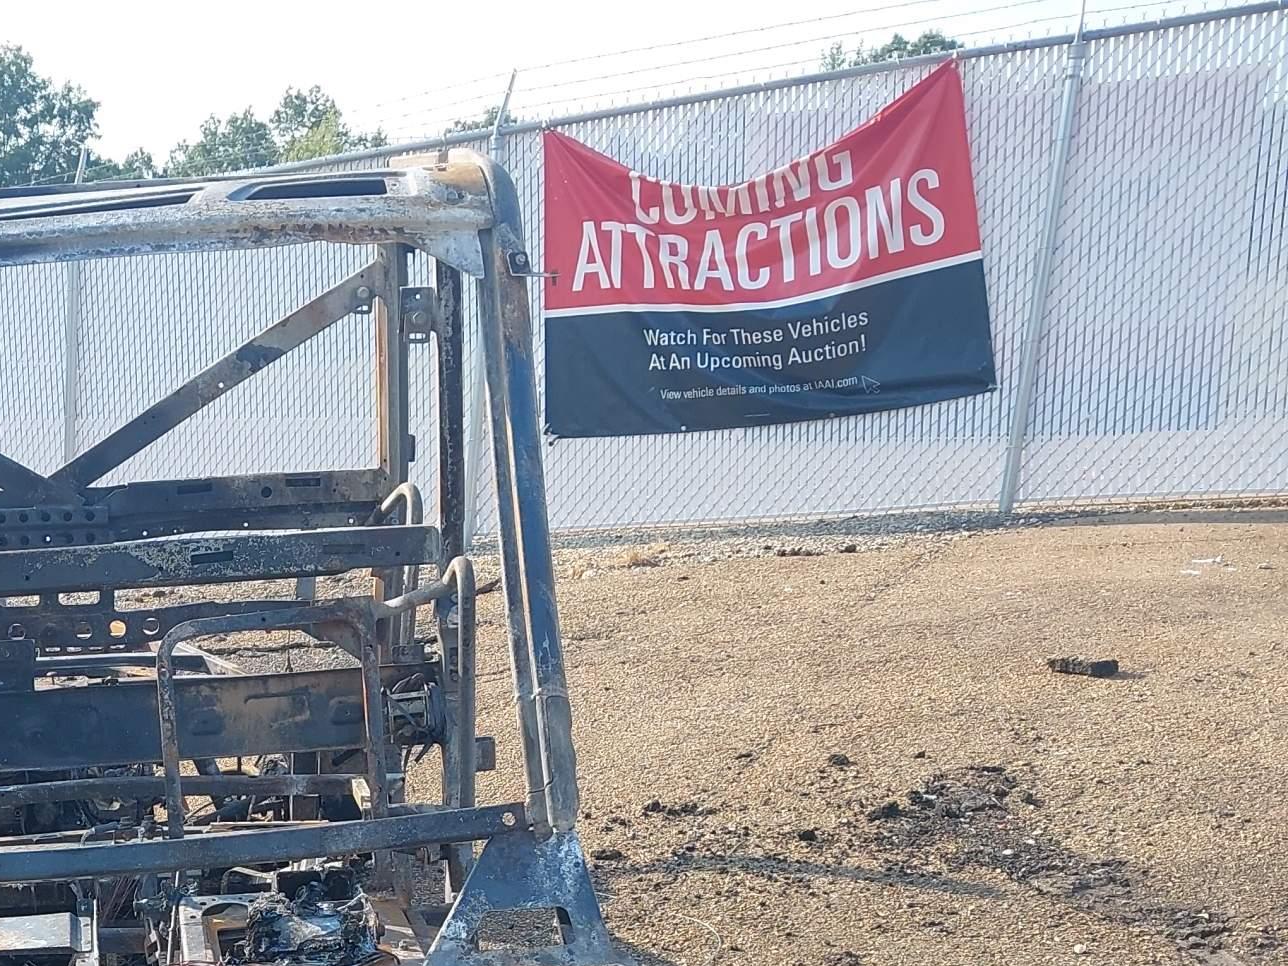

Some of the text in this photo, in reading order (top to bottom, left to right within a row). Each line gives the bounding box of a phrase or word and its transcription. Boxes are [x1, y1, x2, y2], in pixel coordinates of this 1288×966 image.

[628, 149, 854, 226] COMING
[572, 168, 945, 292] ATTRACTIONS
[643, 311, 869, 346] Watch For These Vehicles
[648, 334, 867, 372] At An Upcoming Auction!
[660, 389, 682, 400] View
[682, 386, 715, 399] vehicle
[716, 385, 747, 397] details
[748, 383, 767, 394] and
[768, 382, 801, 395] photos
[803, 381, 813, 391] at
